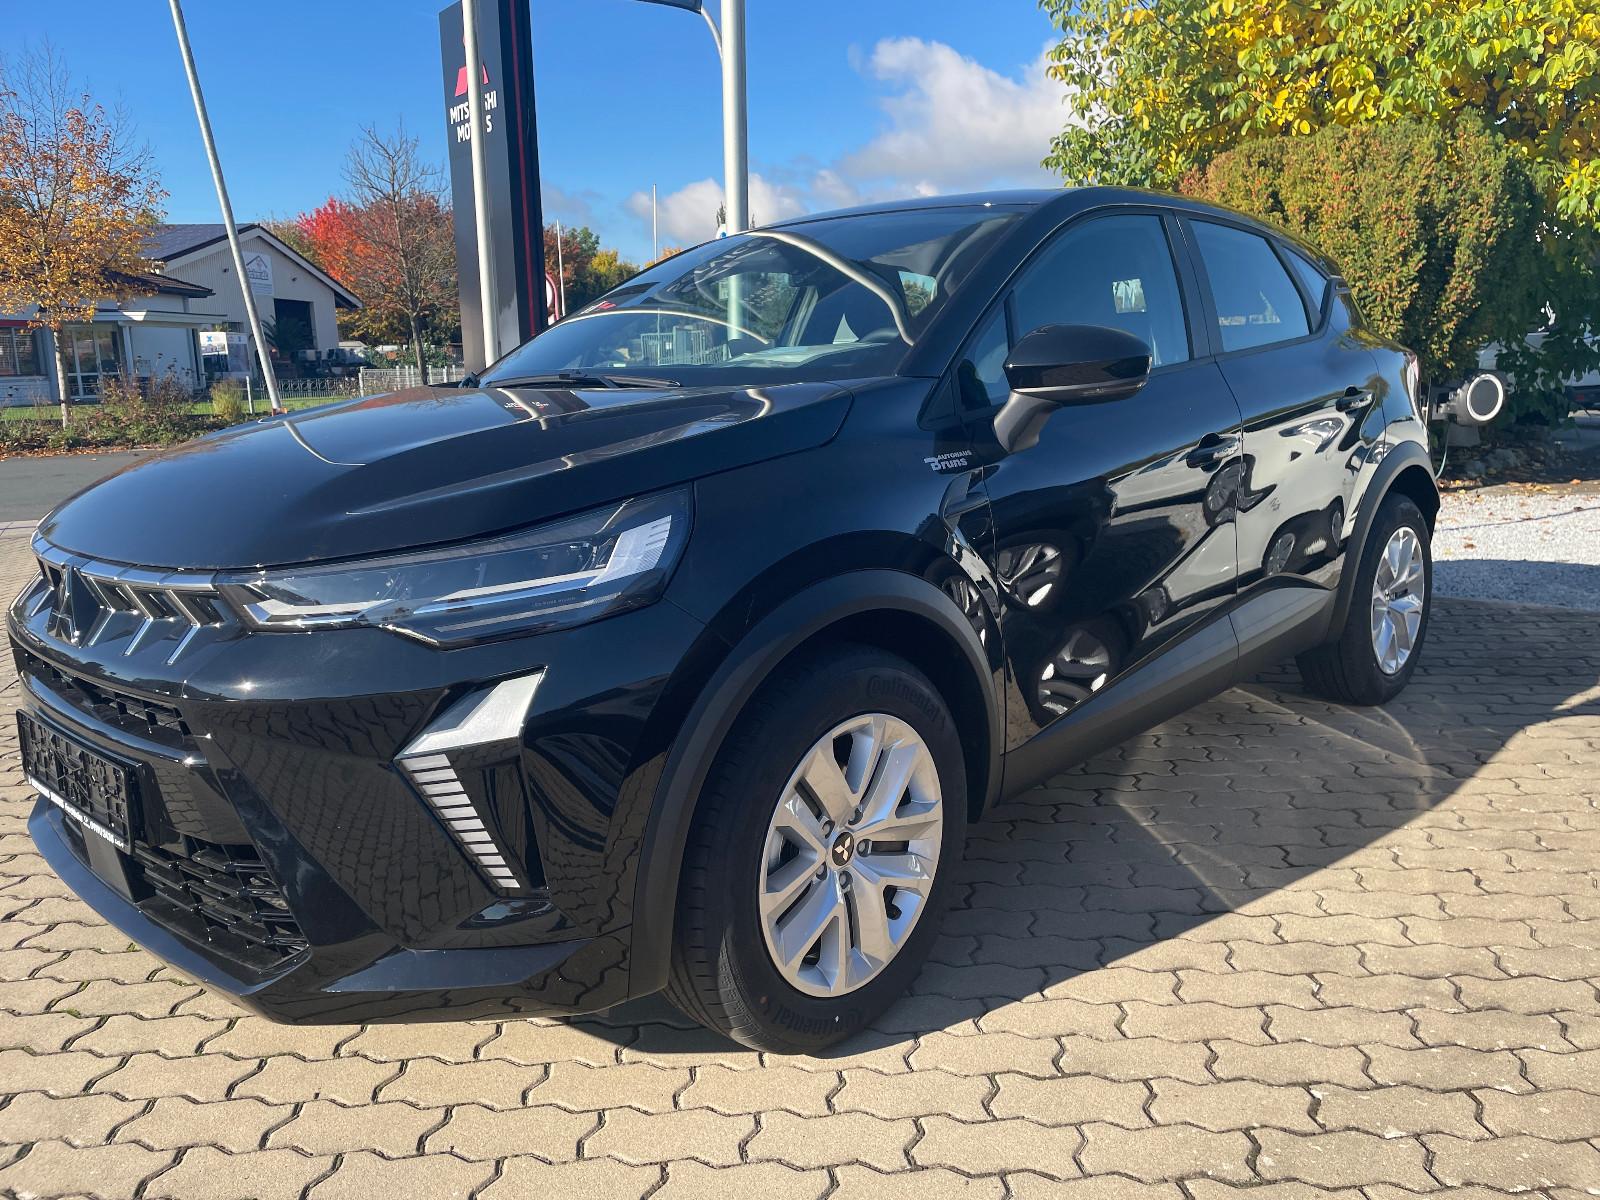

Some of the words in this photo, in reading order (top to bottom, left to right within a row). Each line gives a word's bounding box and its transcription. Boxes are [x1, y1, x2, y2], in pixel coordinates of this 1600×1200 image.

[449, 90, 497, 124] MITSHI
[457, 115, 493, 142] MOS
[924, 457, 967, 470] Bruns
[937, 450, 972, 460] AUTOHAUS
